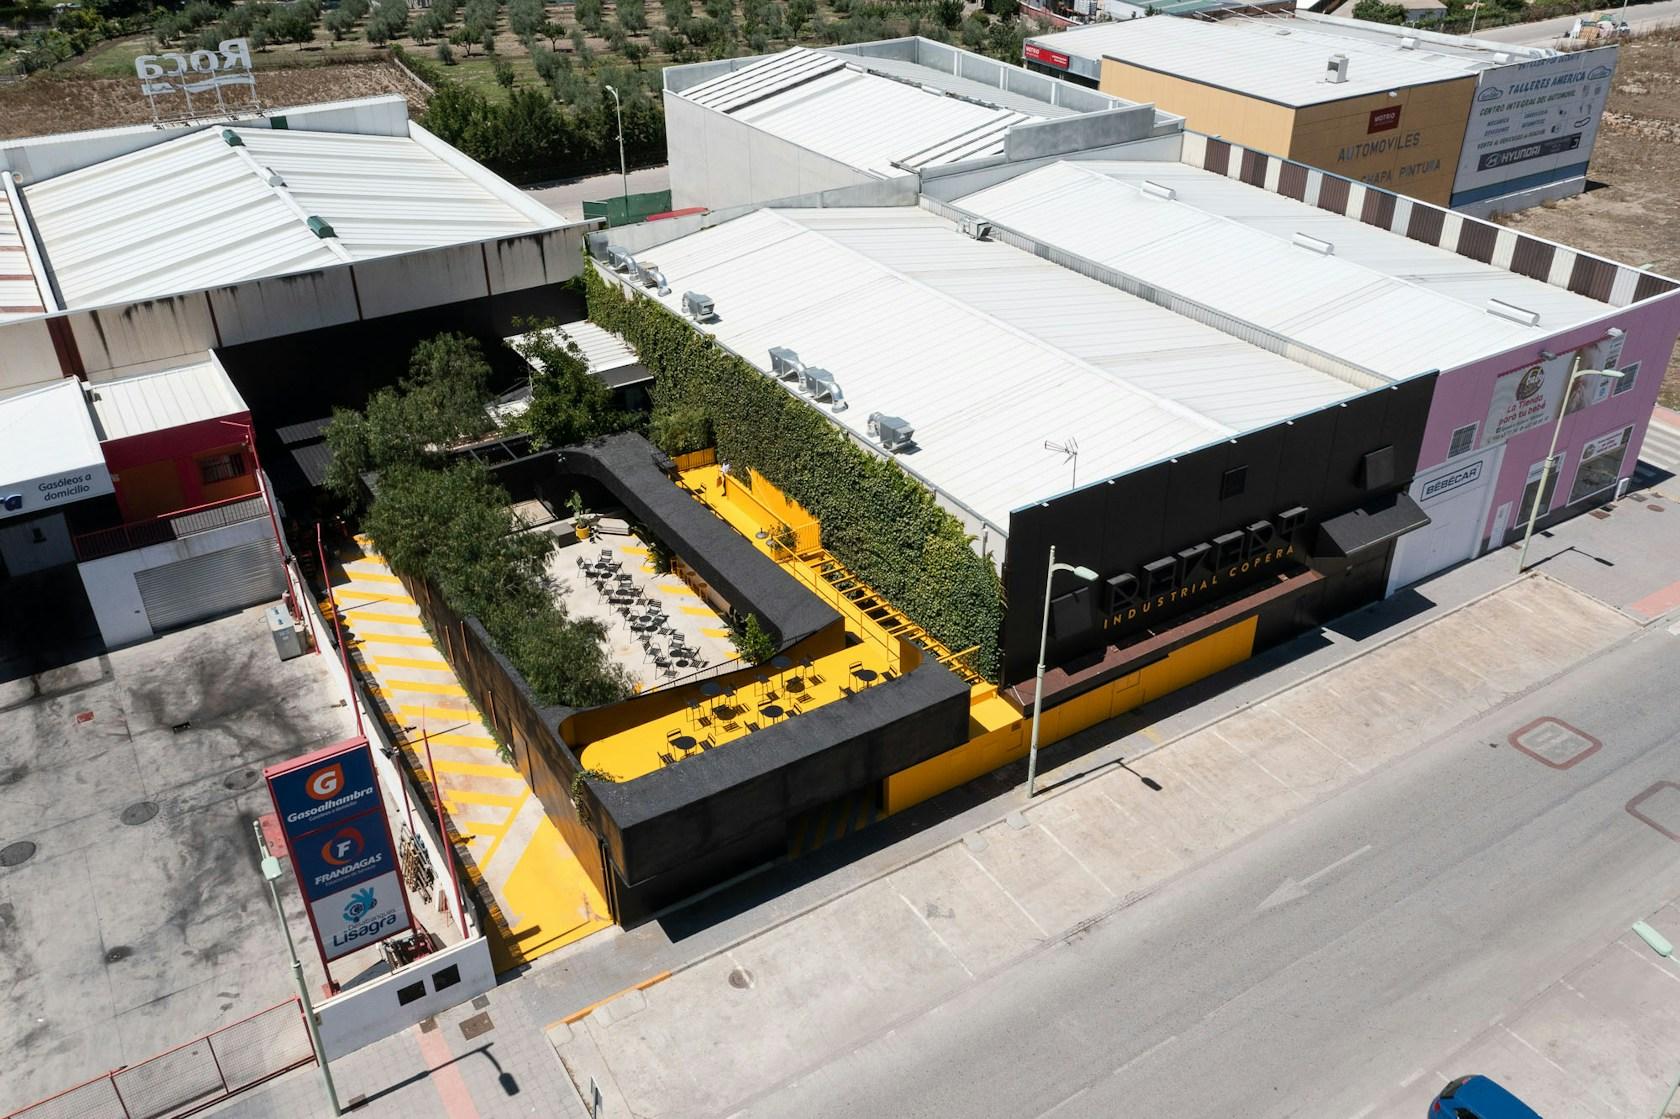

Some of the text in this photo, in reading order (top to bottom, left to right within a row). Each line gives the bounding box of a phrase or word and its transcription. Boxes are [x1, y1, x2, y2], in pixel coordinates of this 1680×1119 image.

[1508, 71, 1586, 95] TALLERES AMERICA
[1337, 132, 1421, 162] AUTOMOVILES
[1500, 145, 1541, 163] HYUNDAI
[1399, 159, 1441, 177] PINTURA
[1507, 404, 1517, 414] La
[38, 473, 92, 492] Gasóleos a
[44, 484, 90, 501] domicilio
[1103, 574, 1218, 630] INDUSTRIAL
[1228, 543, 1295, 577] COPERA
[287, 786, 374, 823] Gasoalhambra
[336, 840, 352, 859] F
[314, 852, 383, 885] FRANDAGAS
[333, 913, 397, 947] Lisagra
